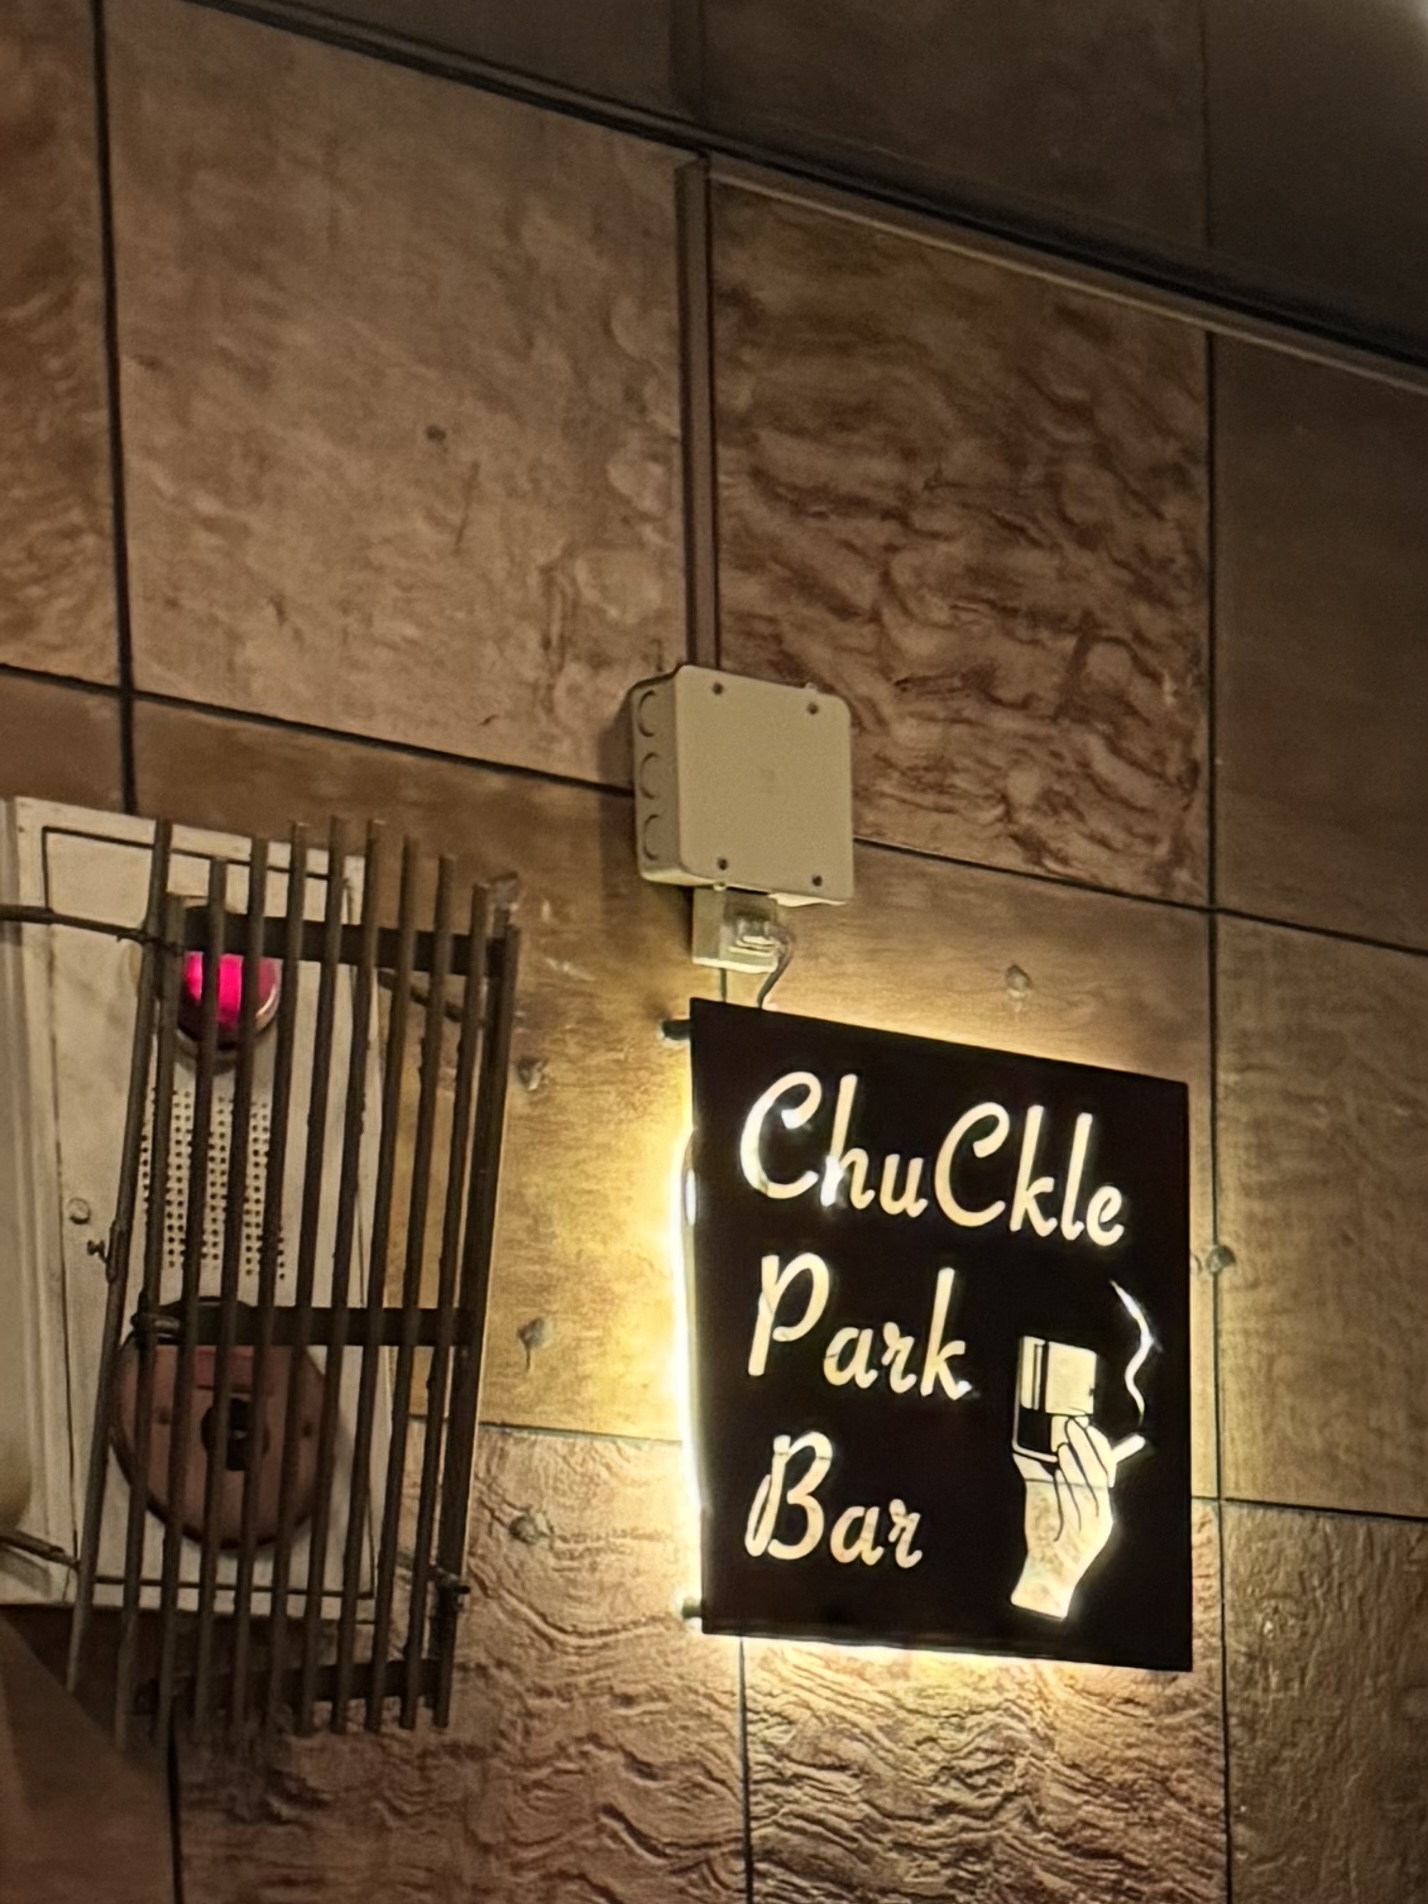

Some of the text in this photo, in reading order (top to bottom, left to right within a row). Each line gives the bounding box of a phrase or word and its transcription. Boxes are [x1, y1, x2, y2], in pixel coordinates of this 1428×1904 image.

[739, 1070, 1126, 1247] ChuCkle
[747, 1252, 973, 1401] Park
[744, 1431, 924, 1569] Bar
